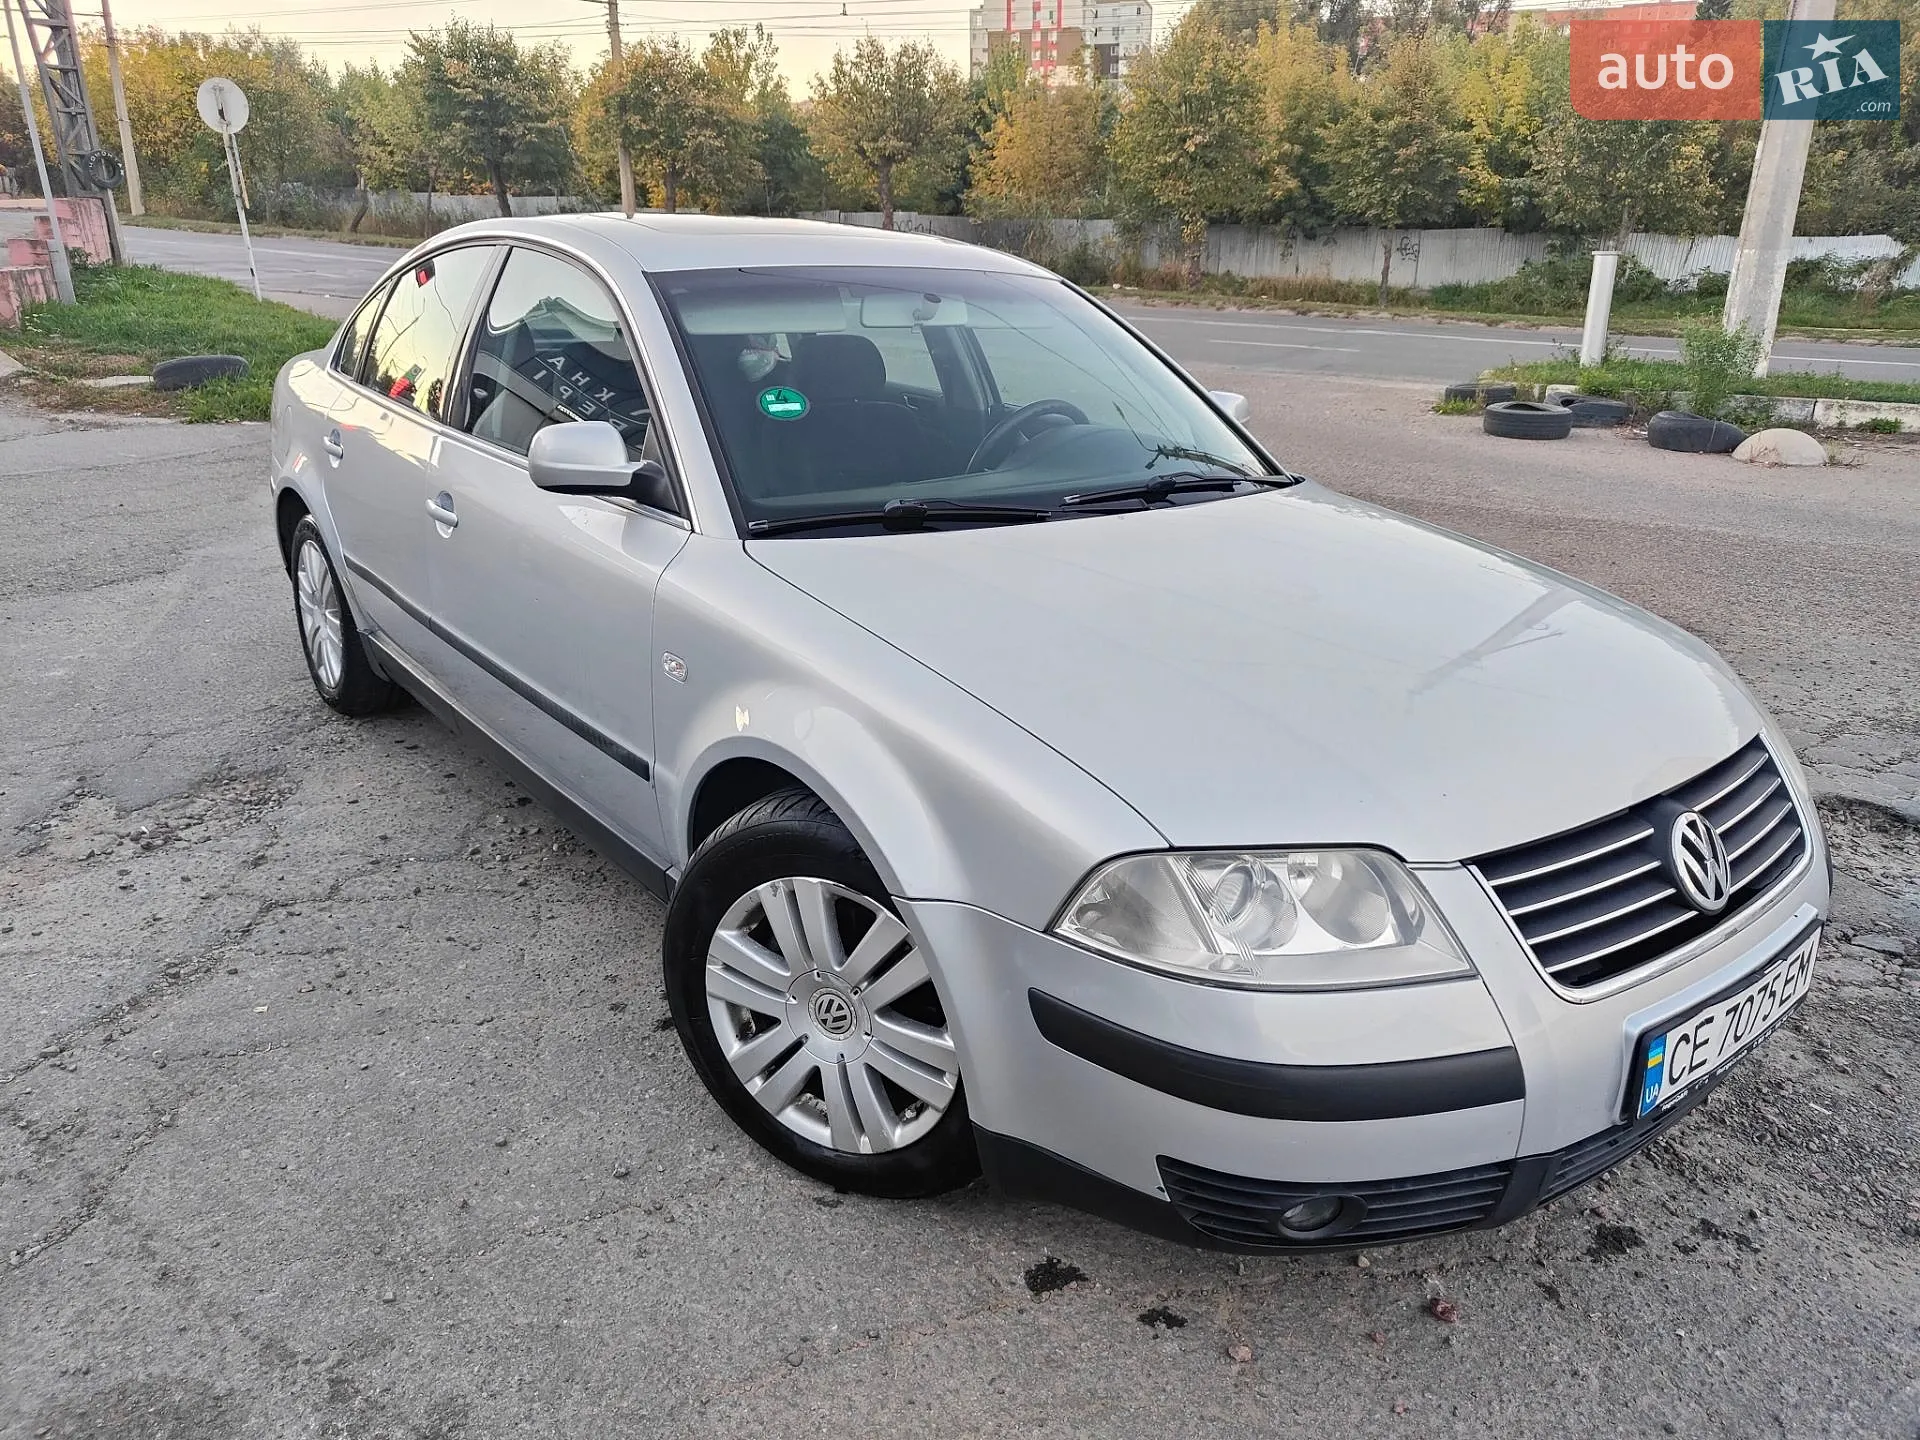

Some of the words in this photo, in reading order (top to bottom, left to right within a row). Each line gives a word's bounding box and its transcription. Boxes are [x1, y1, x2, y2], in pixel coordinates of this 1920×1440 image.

[1668, 1015, 1715, 1086] CE
[1718, 971, 1782, 1057] 7075
[1778, 940, 1815, 1009] EM
[1645, 1083, 1659, 1104] UA
